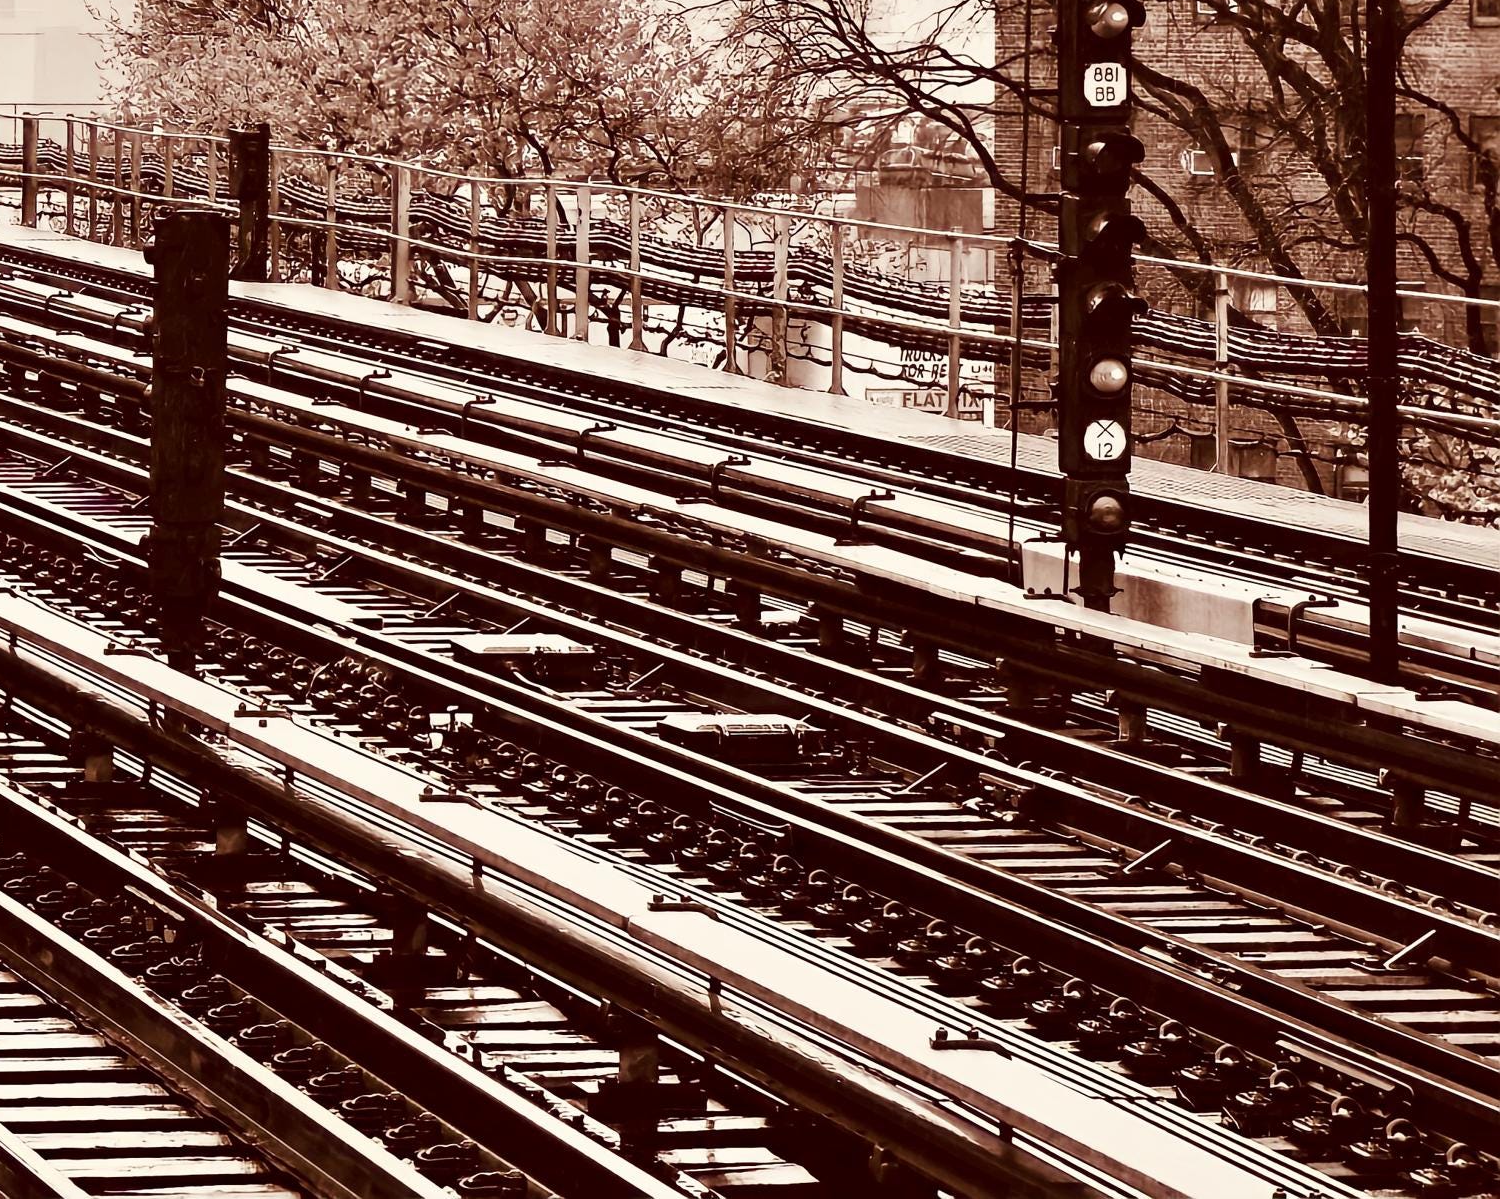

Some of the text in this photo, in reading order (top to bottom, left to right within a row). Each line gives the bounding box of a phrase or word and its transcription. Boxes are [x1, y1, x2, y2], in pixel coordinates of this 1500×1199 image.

[1094, 67, 1118, 82] 881
[931, 363, 963, 379] RET
[902, 392, 946, 407] FLAT
[1098, 443, 1113, 458] 12
